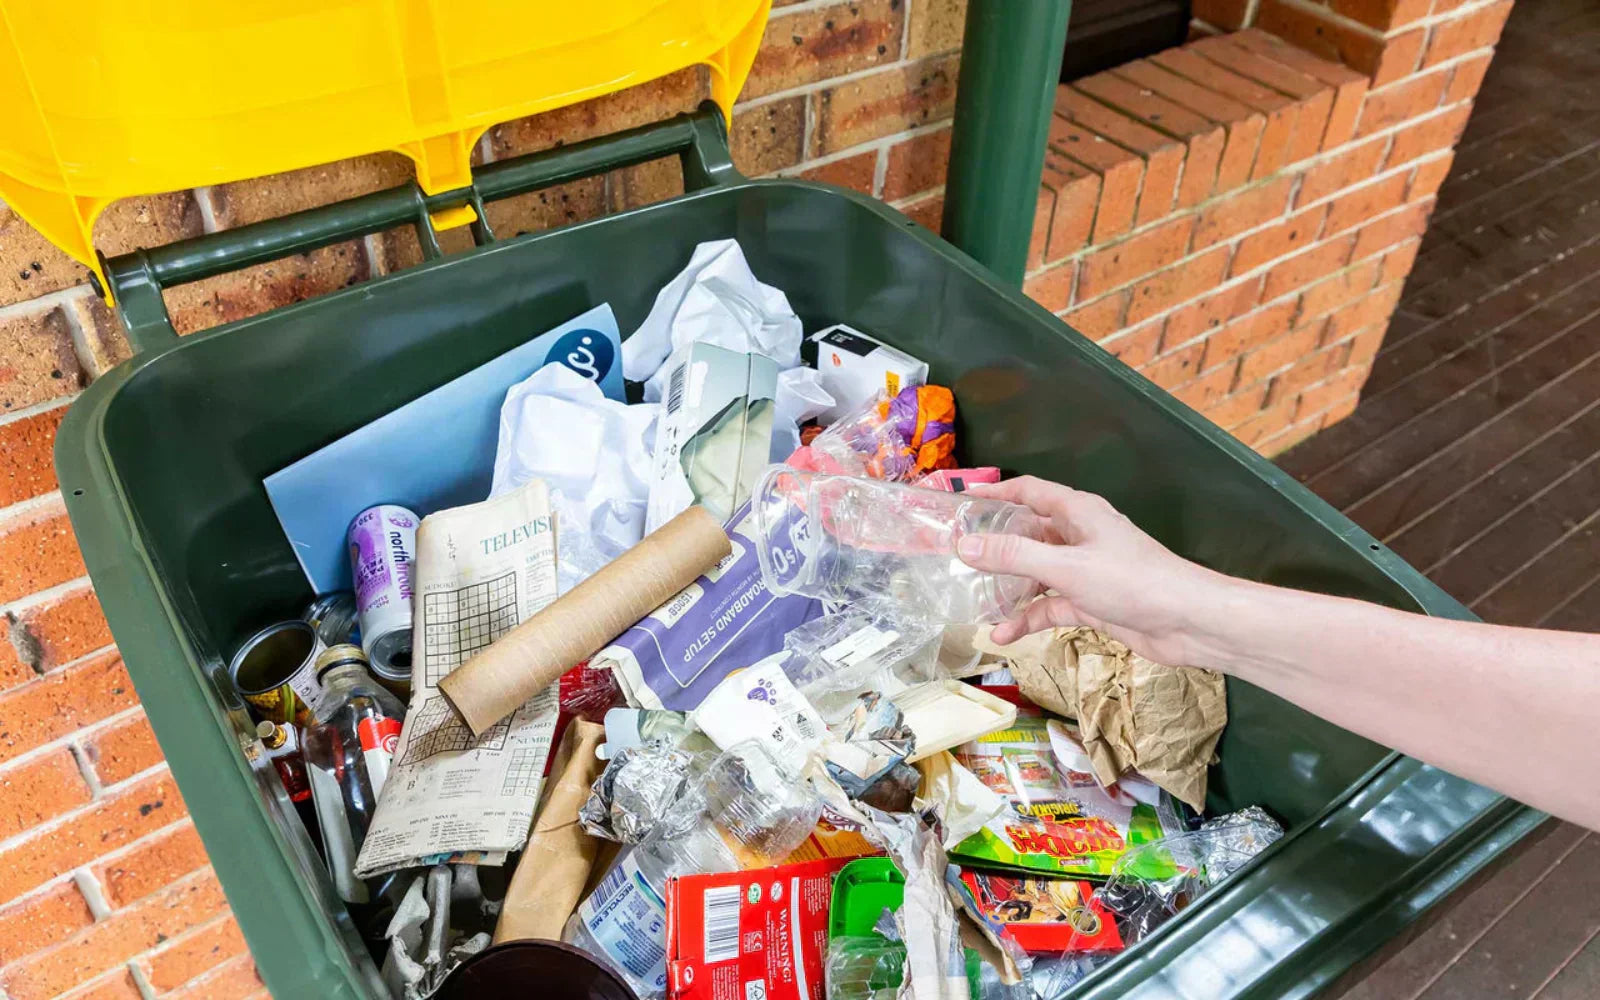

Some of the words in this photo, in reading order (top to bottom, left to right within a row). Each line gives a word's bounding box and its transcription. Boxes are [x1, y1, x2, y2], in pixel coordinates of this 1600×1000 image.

[389, 530, 417, 601] northbrook
[709, 594, 732, 619] CONTRACT
[715, 576, 769, 632] ROADBAND
[682, 624, 718, 663] SETUP
[601, 883, 634, 919] RECYCLE
[589, 917, 603, 931] ME
[780, 908, 791, 983] WARNING!
